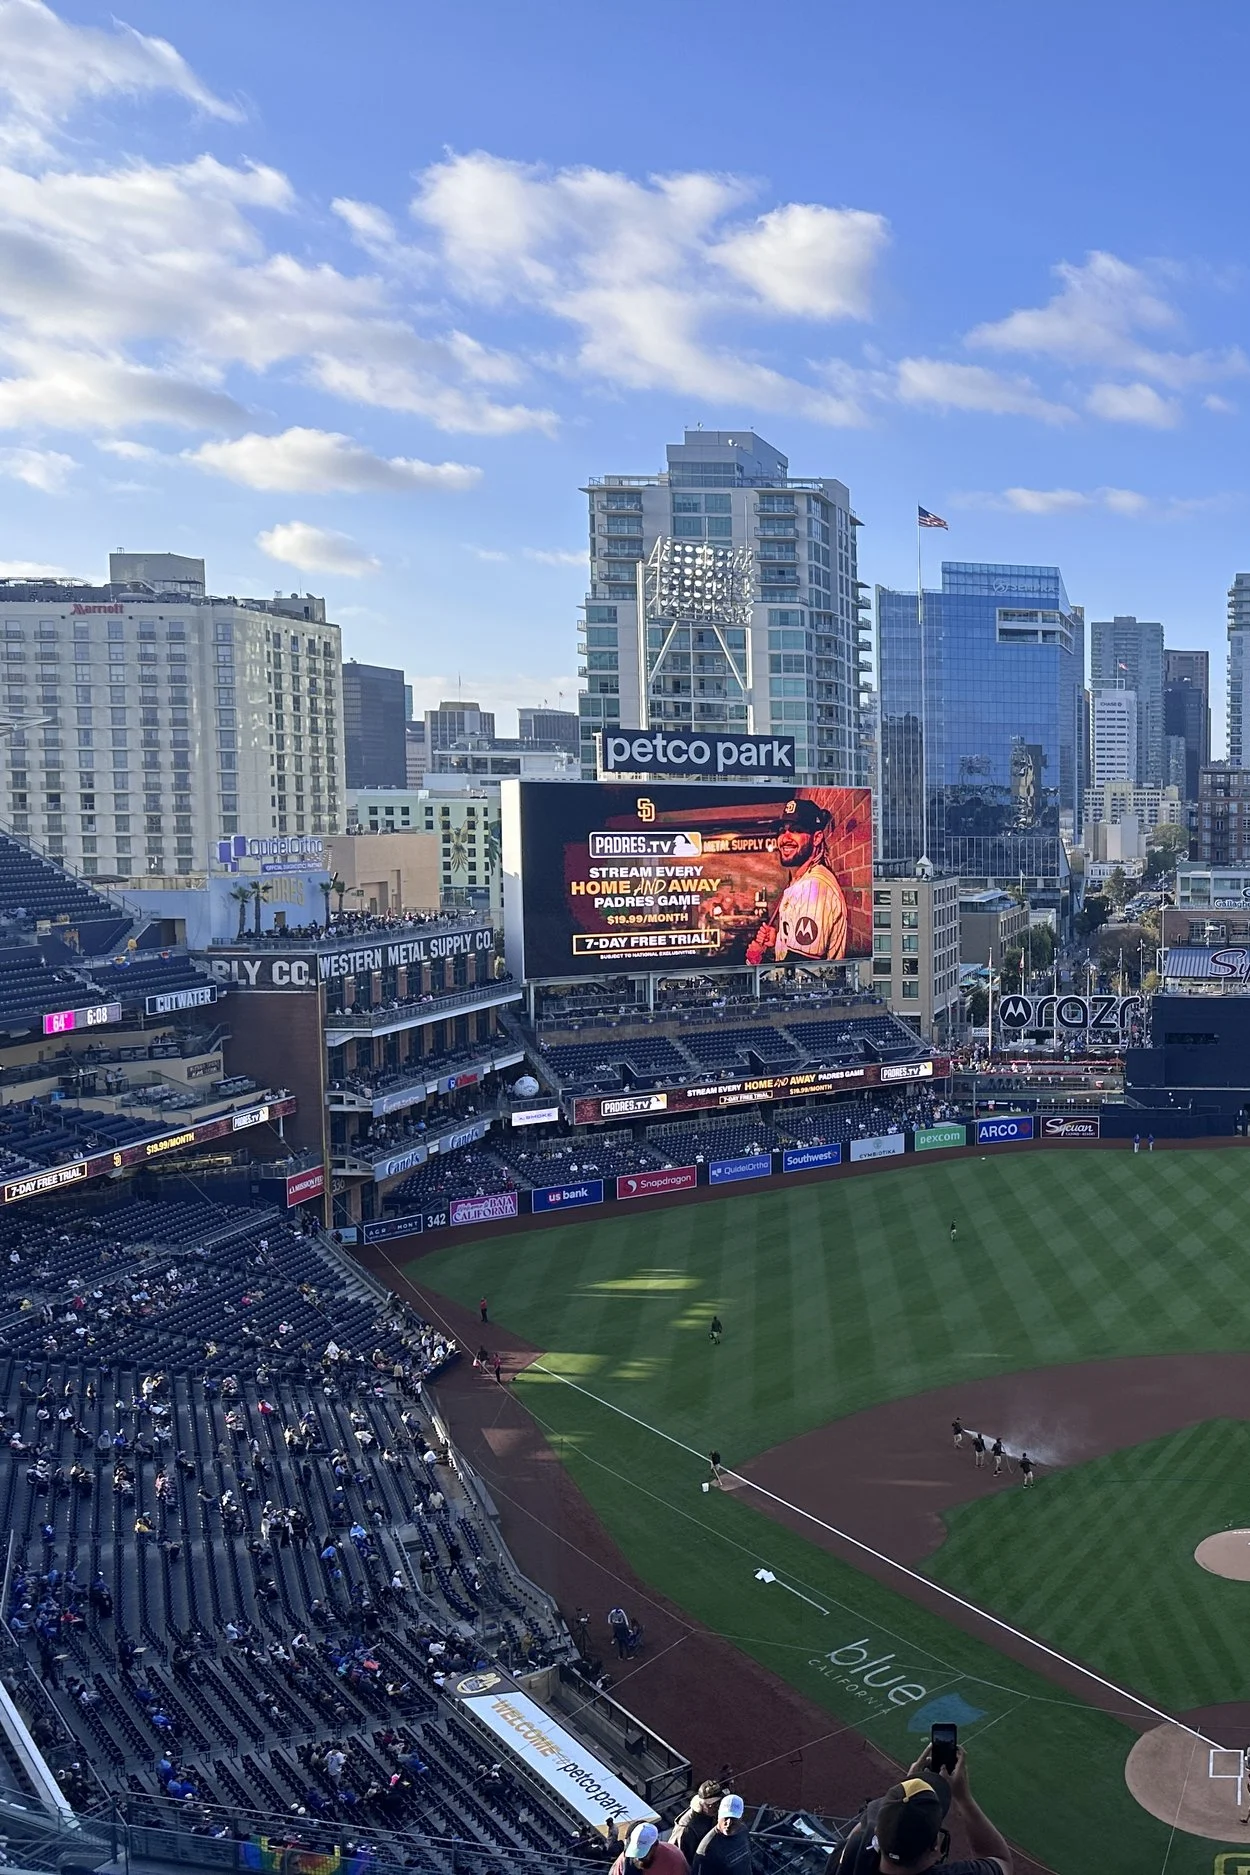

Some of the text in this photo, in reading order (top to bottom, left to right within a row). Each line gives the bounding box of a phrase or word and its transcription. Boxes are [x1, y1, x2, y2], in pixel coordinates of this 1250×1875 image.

[605, 733, 793, 773] petco park
[249, 837, 324, 857] QuidelOrtho
[595, 836, 671, 853] PADRES.TV
[731, 839, 763, 851] SUPPLY
[589, 866, 704, 879] STREAM EVERY
[571, 878, 721, 896] HOME AND AWAY
[594, 894, 701, 909] PADRES GAME
[607, 913, 689, 925] $19.99/MONTH
[585, 934, 710, 950] 7-DAY FREE TRIAL
[318, 930, 494, 978] WESTERN METAL SUPPLY CO.
[272, 960, 316, 986] CO.
[156, 989, 211, 1012] CUTWATER
[87, 1007, 108, 1025] 6:08
[1036, 994, 1141, 1029] razr
[687, 1087, 717, 1097] STREAM
[718, 1083, 742, 1093] EVERY
[745, 1079, 773, 1091] HOME
[790, 1074, 816, 1086] AWAY
[818, 1071, 845, 1081] PADRES
[845, 1069, 865, 1078] GAME
[980, 1124, 1018, 1139] ARCO
[1045, 1118, 1094, 1136] Sycuan
[386, 1152, 420, 1176] Canel's
[787, 1151, 832, 1166] Southwest
[724, 1161, 769, 1175] QuidelOrtho
[10, 1167, 82, 1198] 7-DAY FREE TRIAL
[640, 1173, 692, 1189] Snapdragon
[548, 1187, 588, 1202] us bank
[428, 1213, 447, 1228] 342
[453, 1205, 516, 1223] CALIFORNIA
[826, 1638, 928, 1706] blue
[807, 1658, 889, 1715] CALIFORNIA
[491, 1699, 629, 1819] WELCOME petco park
